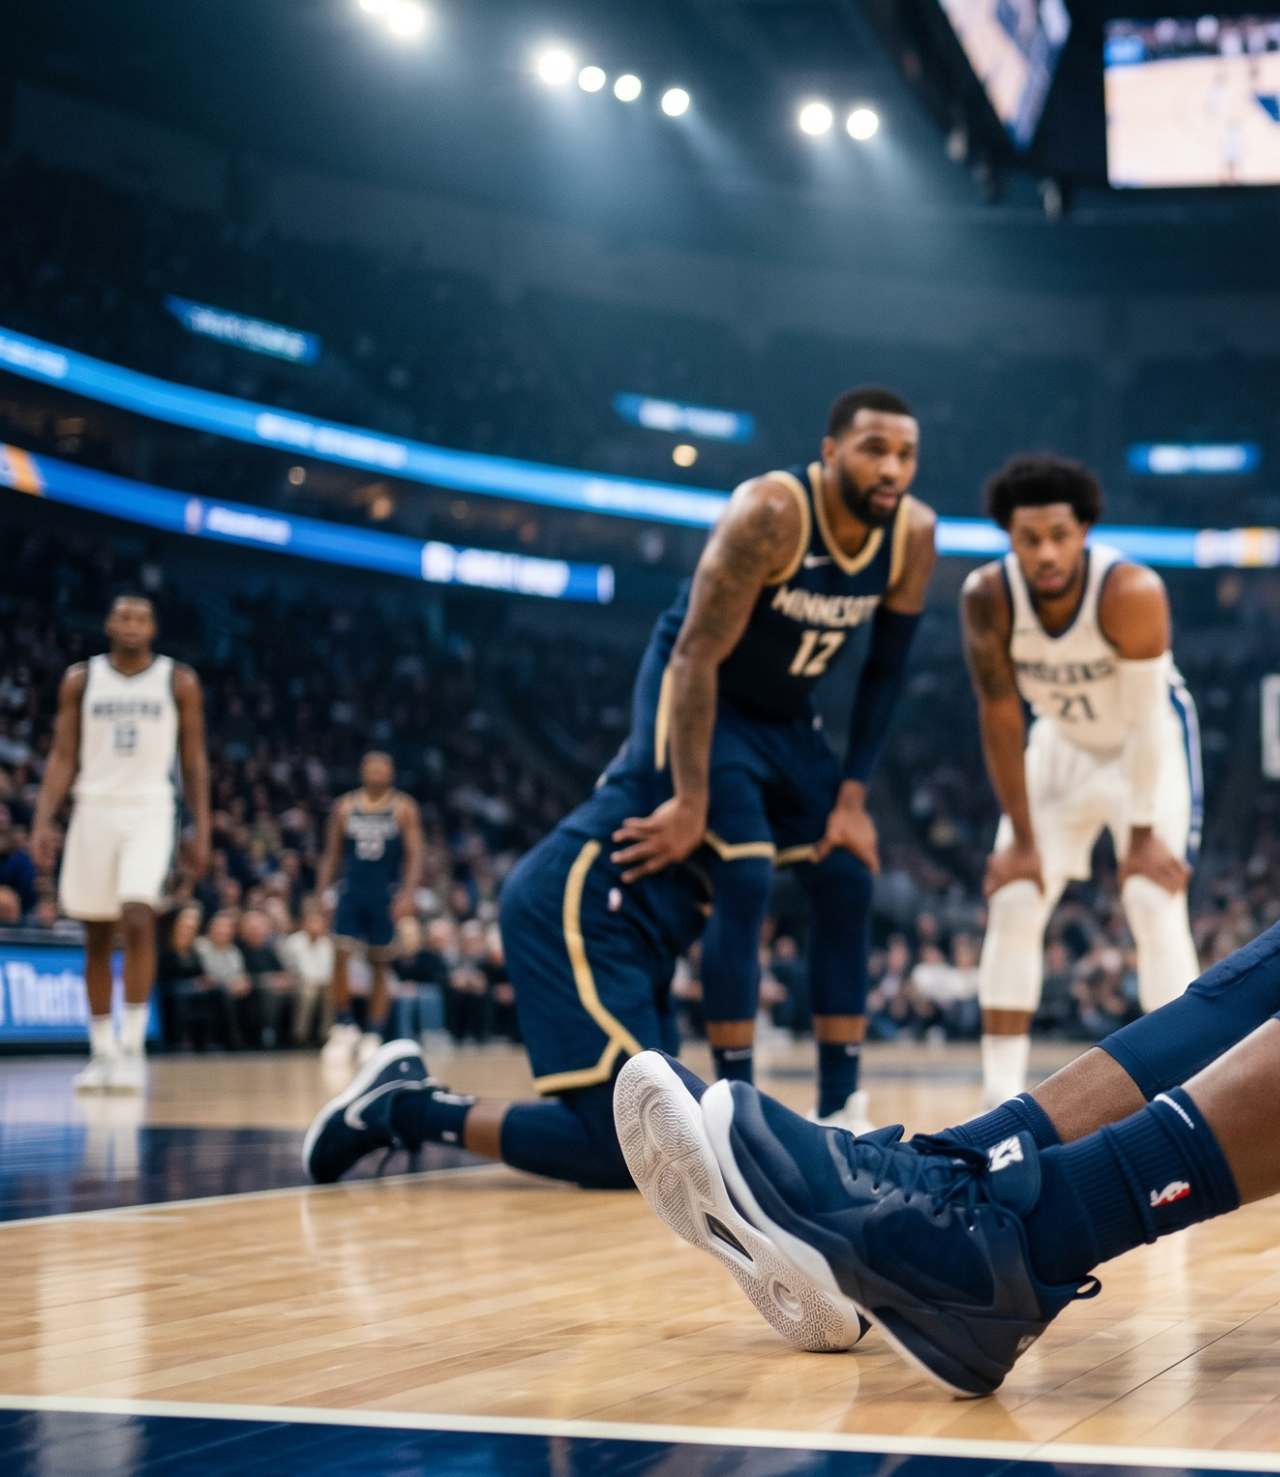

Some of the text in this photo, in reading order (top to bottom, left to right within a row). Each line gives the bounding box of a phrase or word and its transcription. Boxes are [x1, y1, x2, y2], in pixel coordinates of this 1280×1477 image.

[770, 585, 881, 628] MINNESOT
[788, 630, 846, 677] 12
[1051, 693, 1095, 721] 21
